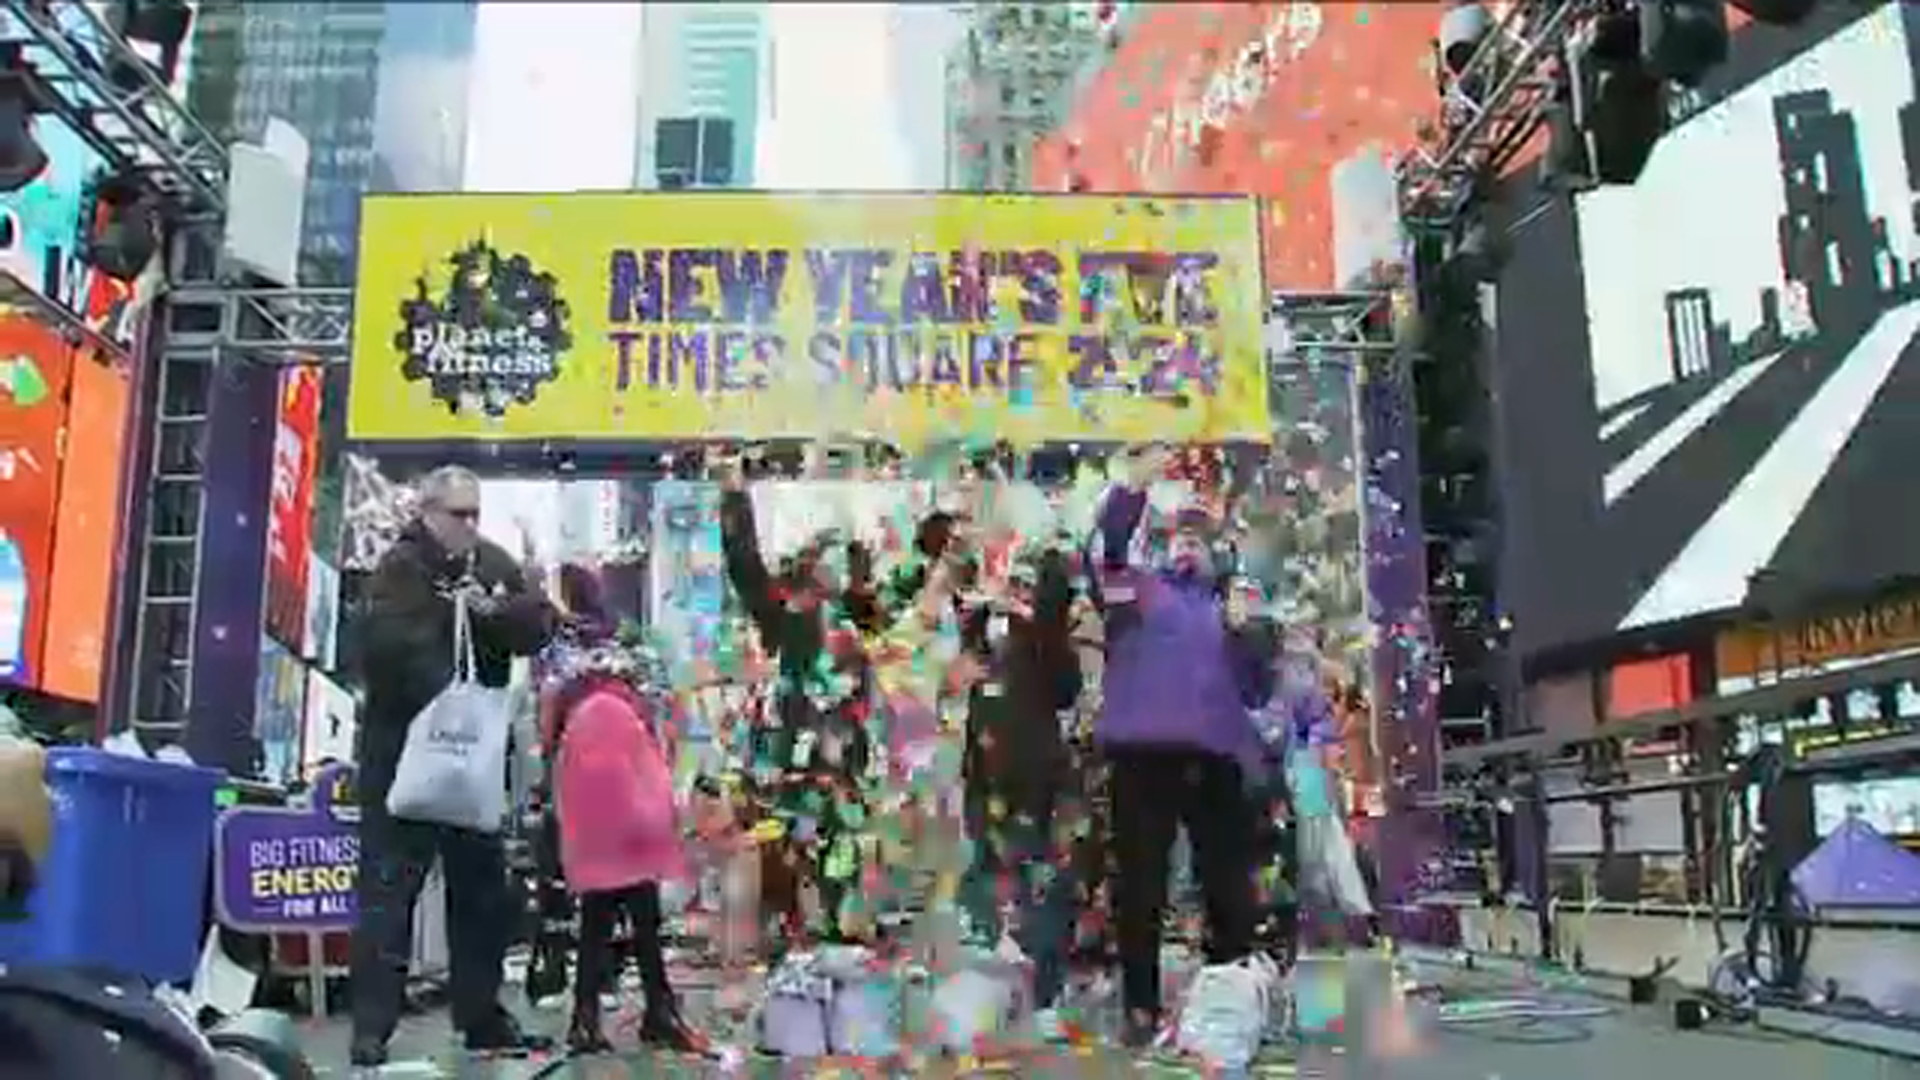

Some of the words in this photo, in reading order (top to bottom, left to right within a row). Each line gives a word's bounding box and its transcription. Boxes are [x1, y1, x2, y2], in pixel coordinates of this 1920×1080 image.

[608, 249, 789, 322] NEW
[608, 332, 786, 391] TIMES
[250, 839, 284, 868] BIG
[288, 835, 361, 865] FITNES
[283, 898, 316, 917] FOR
[321, 896, 350, 914] ALL
